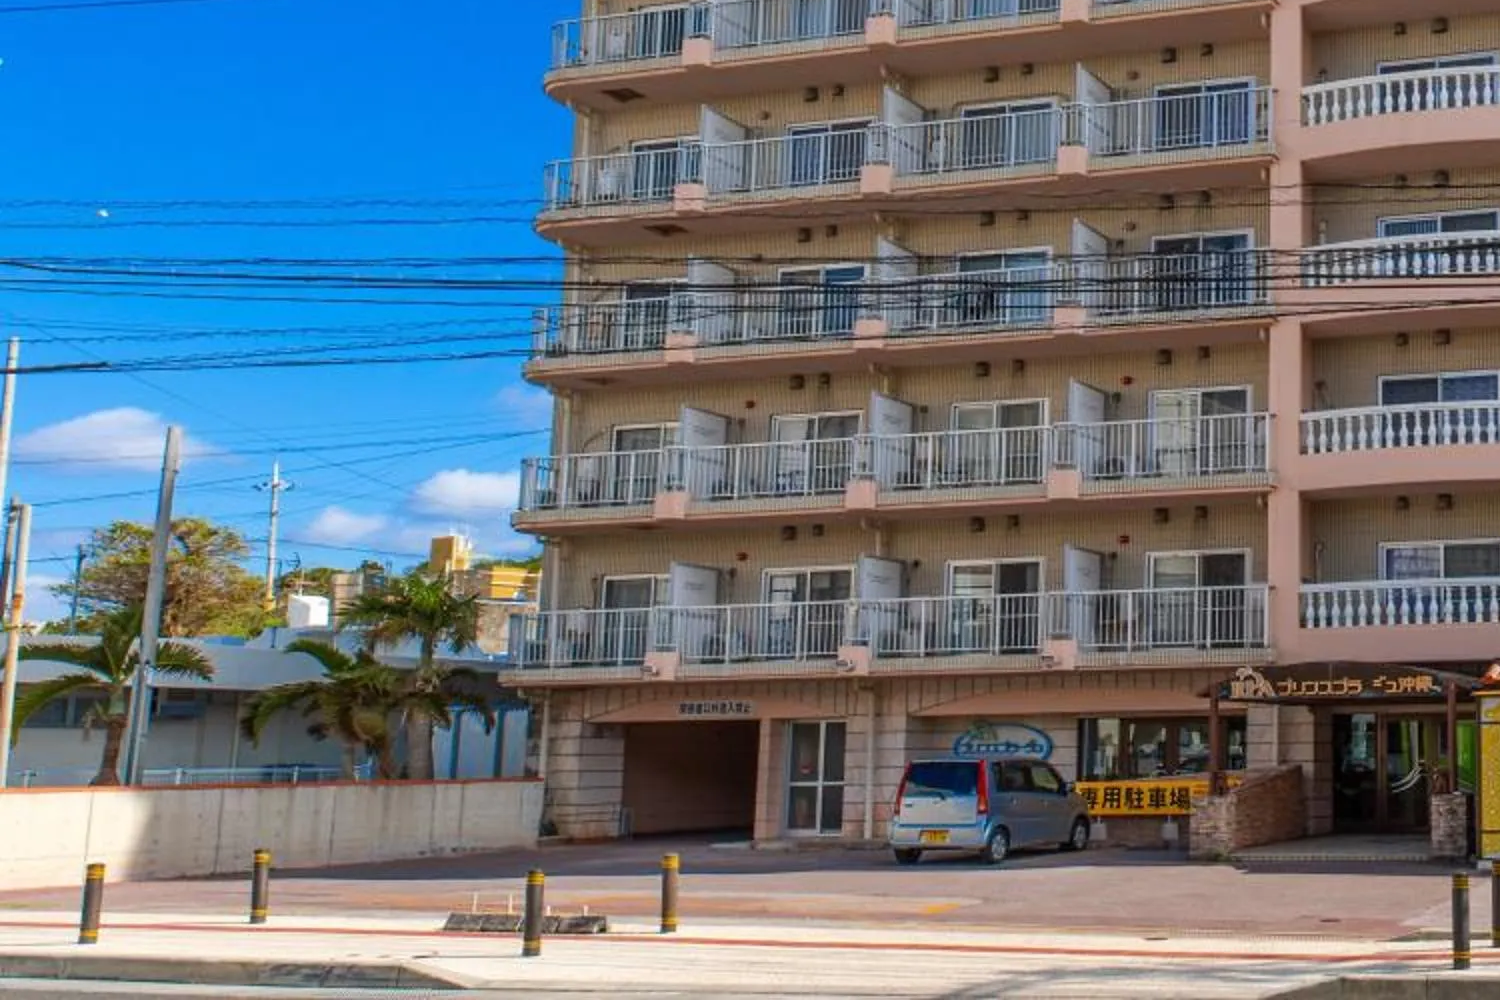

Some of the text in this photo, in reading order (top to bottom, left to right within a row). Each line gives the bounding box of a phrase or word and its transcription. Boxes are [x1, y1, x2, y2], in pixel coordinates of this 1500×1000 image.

[1079, 786, 1191, 809] 専用駐車場
